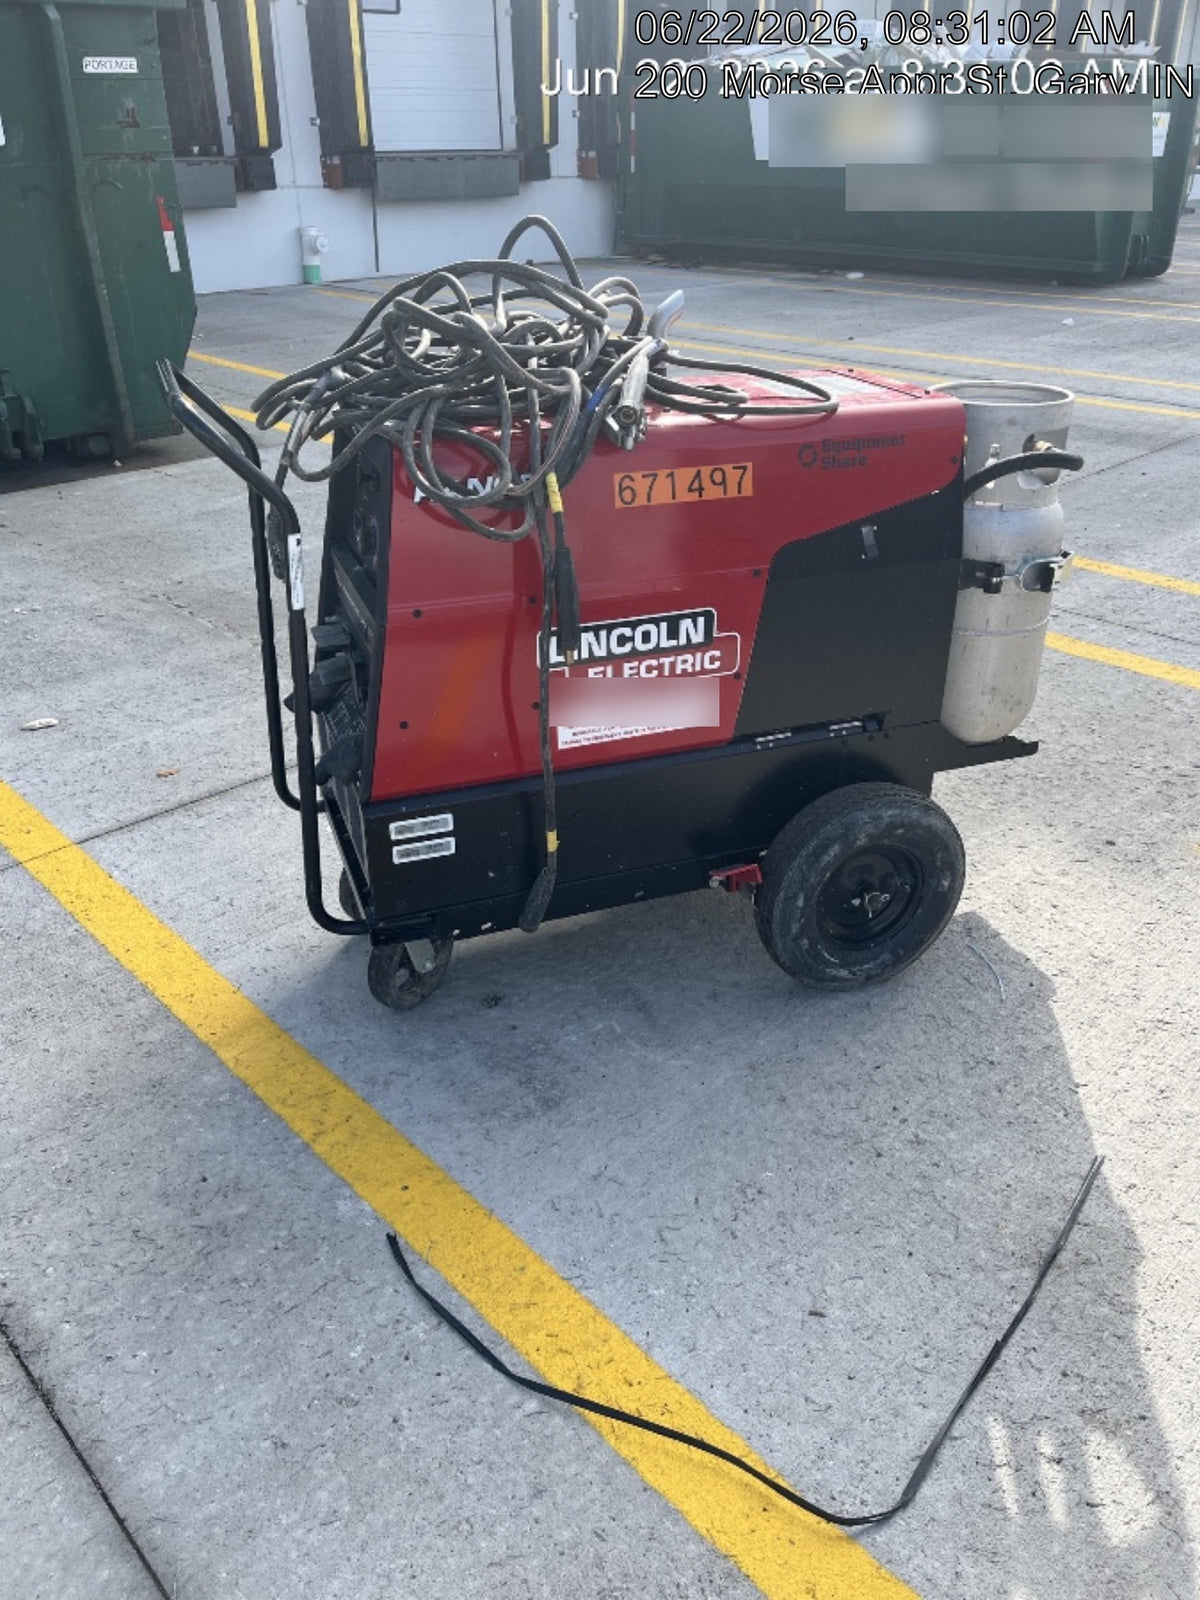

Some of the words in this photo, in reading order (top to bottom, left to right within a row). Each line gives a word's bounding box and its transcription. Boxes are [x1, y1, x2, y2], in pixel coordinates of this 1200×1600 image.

[821, 434, 906, 454] Equipment
[821, 455, 867, 470] Share
[617, 465, 749, 506] 671497
[549, 616, 705, 664] LNCOLN
